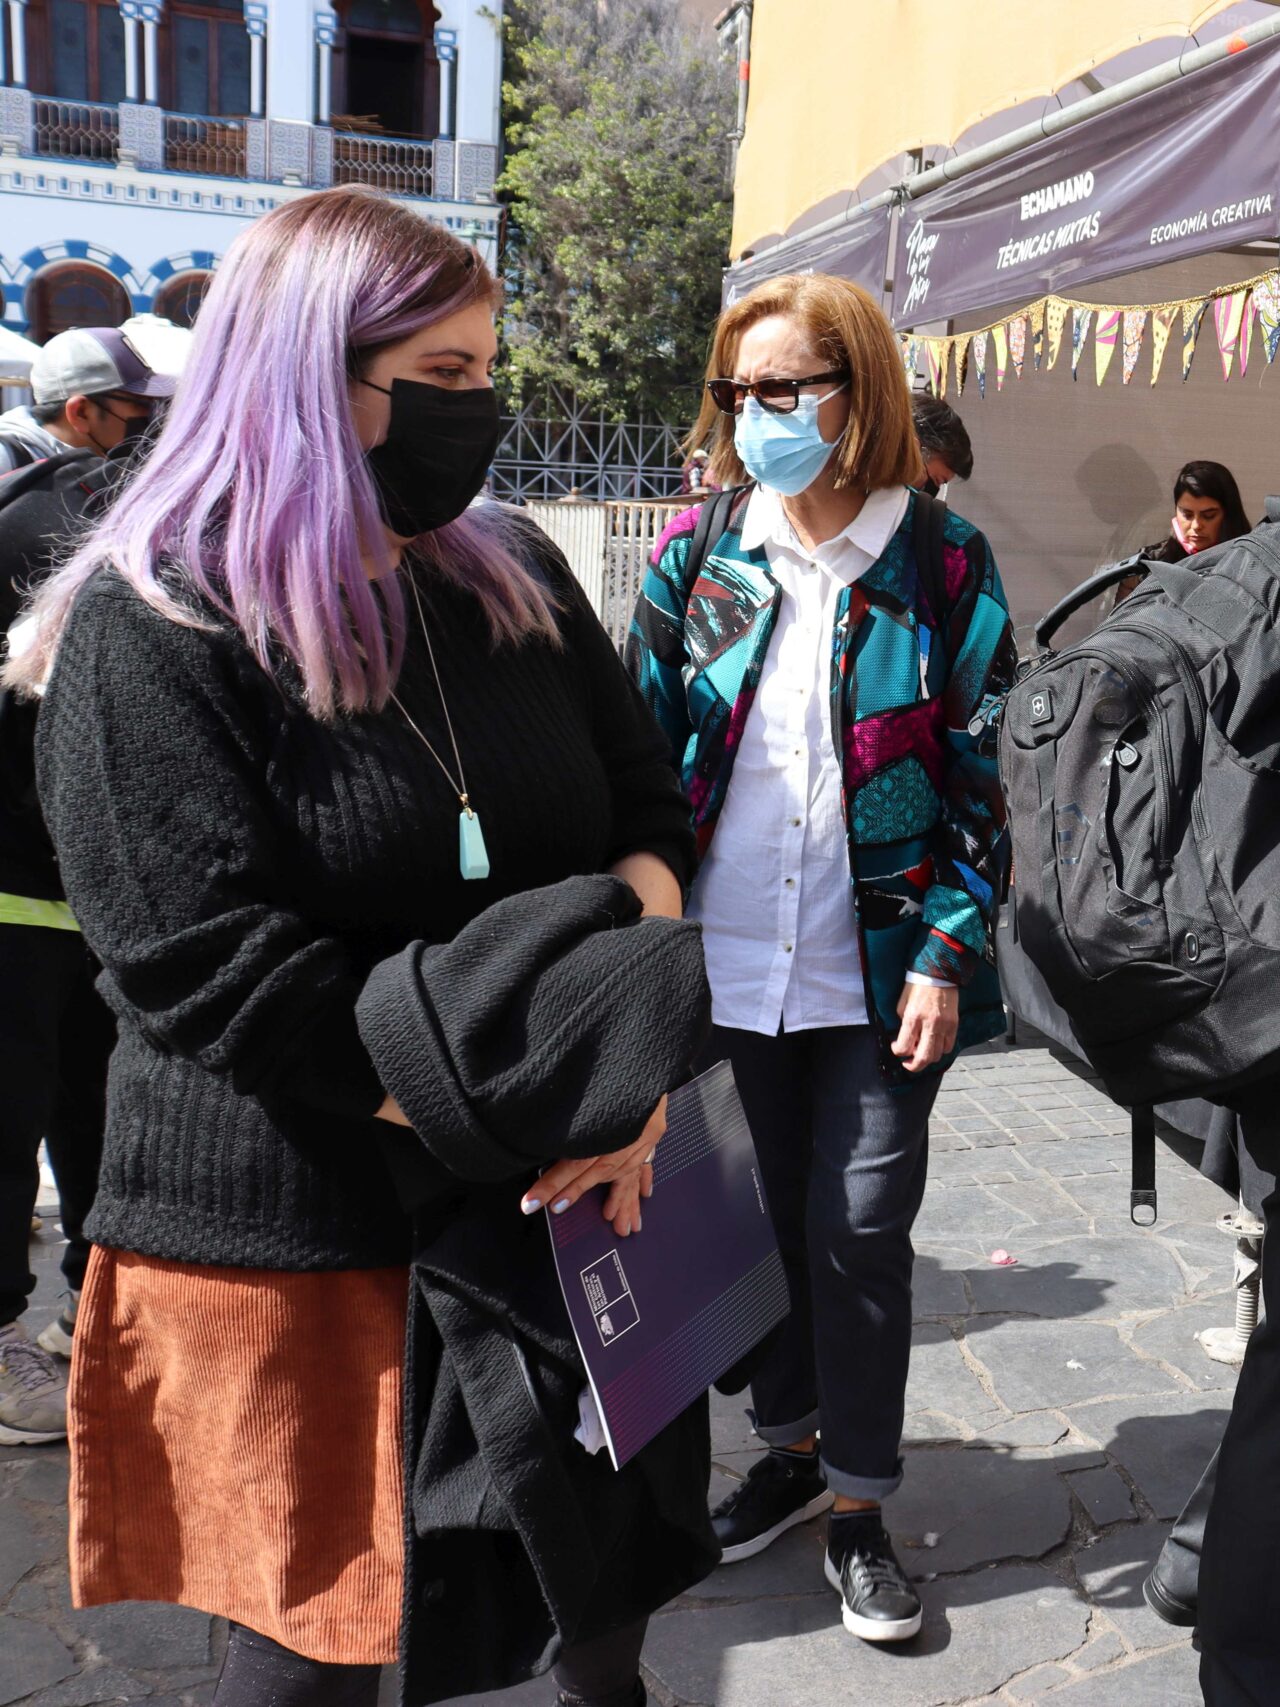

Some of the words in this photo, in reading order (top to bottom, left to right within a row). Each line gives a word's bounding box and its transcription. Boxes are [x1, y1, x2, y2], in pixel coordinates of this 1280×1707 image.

[1021, 171, 1094, 221] ECHAMANO
[1150, 210, 1208, 245] ECONOMÍA
[1211, 194, 1272, 227] CREATIVA
[997, 230, 1055, 270] TÉCNICAS
[1052, 211, 1101, 250] MIXTAS
